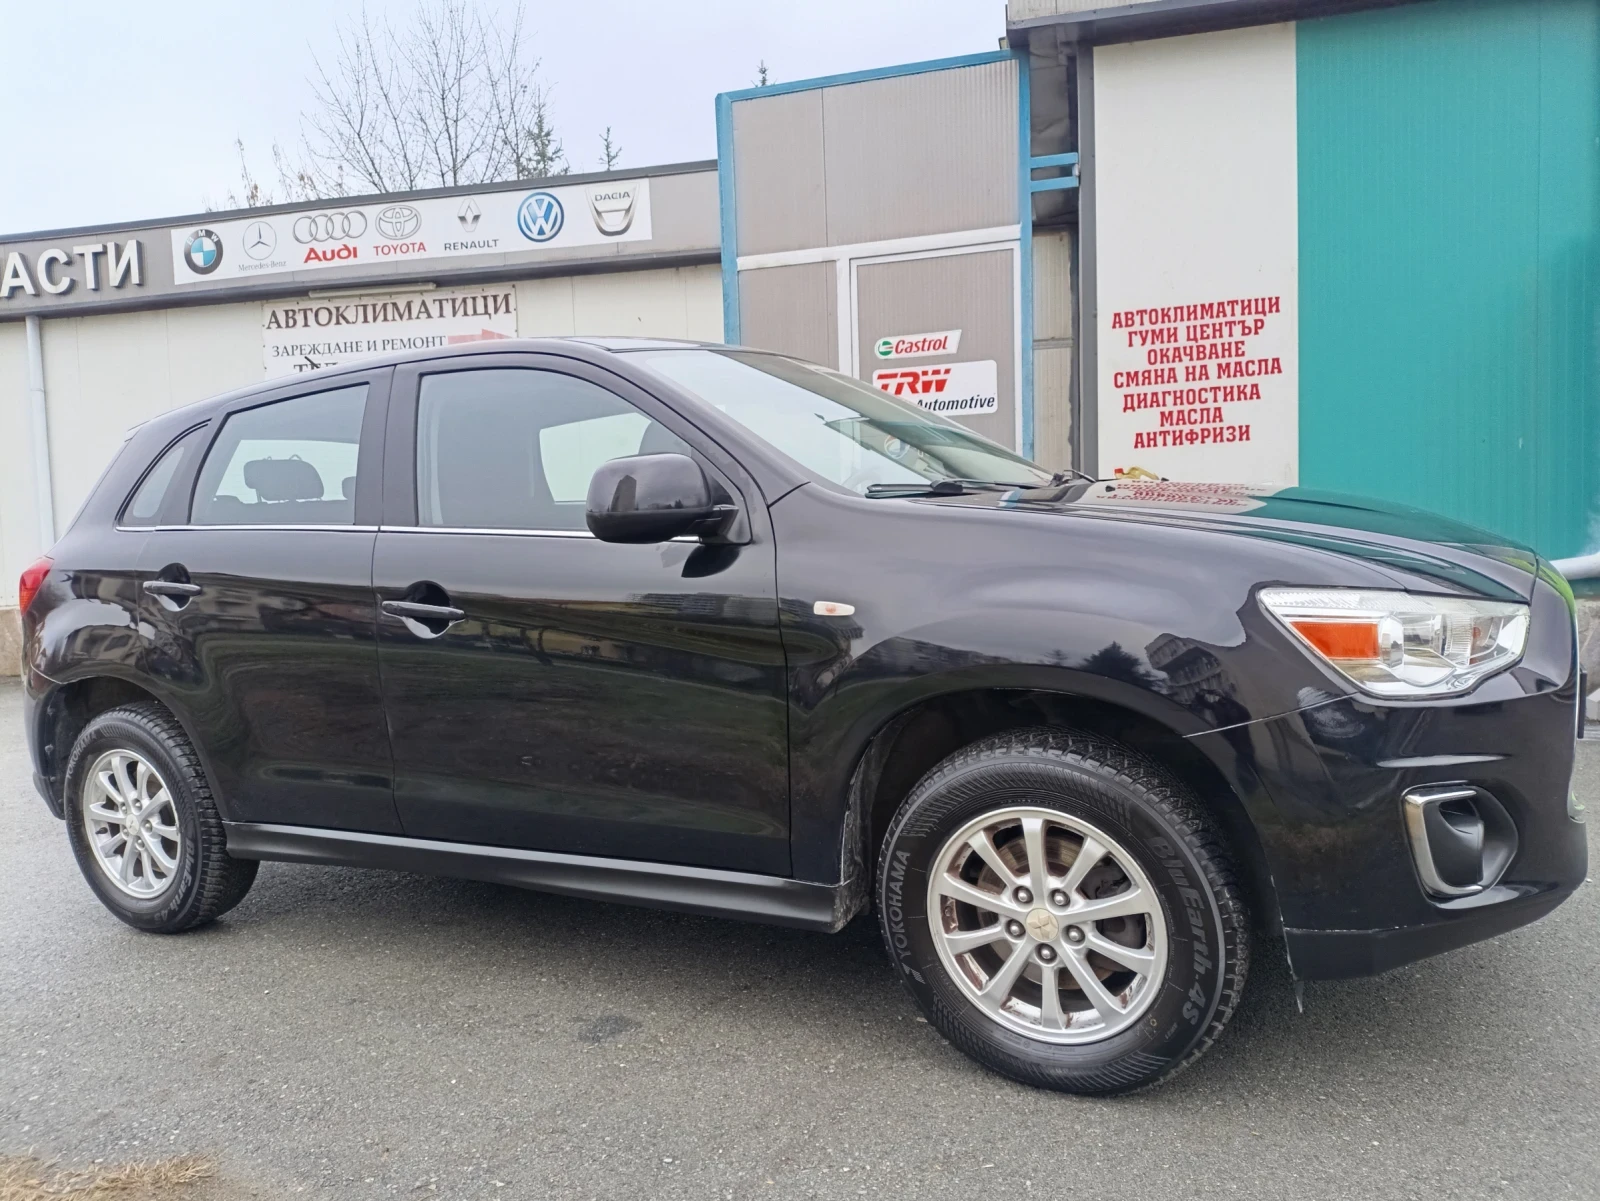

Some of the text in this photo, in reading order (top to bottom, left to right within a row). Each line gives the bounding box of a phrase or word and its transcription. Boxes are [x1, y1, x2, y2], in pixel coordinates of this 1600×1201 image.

[594, 191, 631, 201] DACIA
[303, 244, 358, 263] Audi
[373, 241, 427, 256] TOYOTA
[444, 238, 499, 251] RENAULT
[0, 239, 142, 298] АСТИ
[238, 260, 288, 272] Mercedes-Benz
[266, 293, 512, 329] АВТОКЛИМАТИЦИ
[1112, 296, 1281, 329] АВТОКЛИМАТИЦИ
[1127, 318, 1265, 347] ГУМИ ЦЕНТЪР
[272, 335, 446, 357] ЗАРЕЖДАНЕ И РЕМОНТ
[895, 336, 948, 354] Castrol
[1147, 340, 1246, 365] ОКАЧВАНЕ
[877, 368, 951, 395] TRW
[1113, 357, 1283, 388] СМЯНА НА МАСЛА
[1123, 383, 1261, 413] ДИАГНОСТИКА
[1160, 406, 1224, 427] МАСЛА
[1133, 425, 1251, 449] АНТИФРИЗИ
[888, 850, 911, 959] YOKOHAMA
